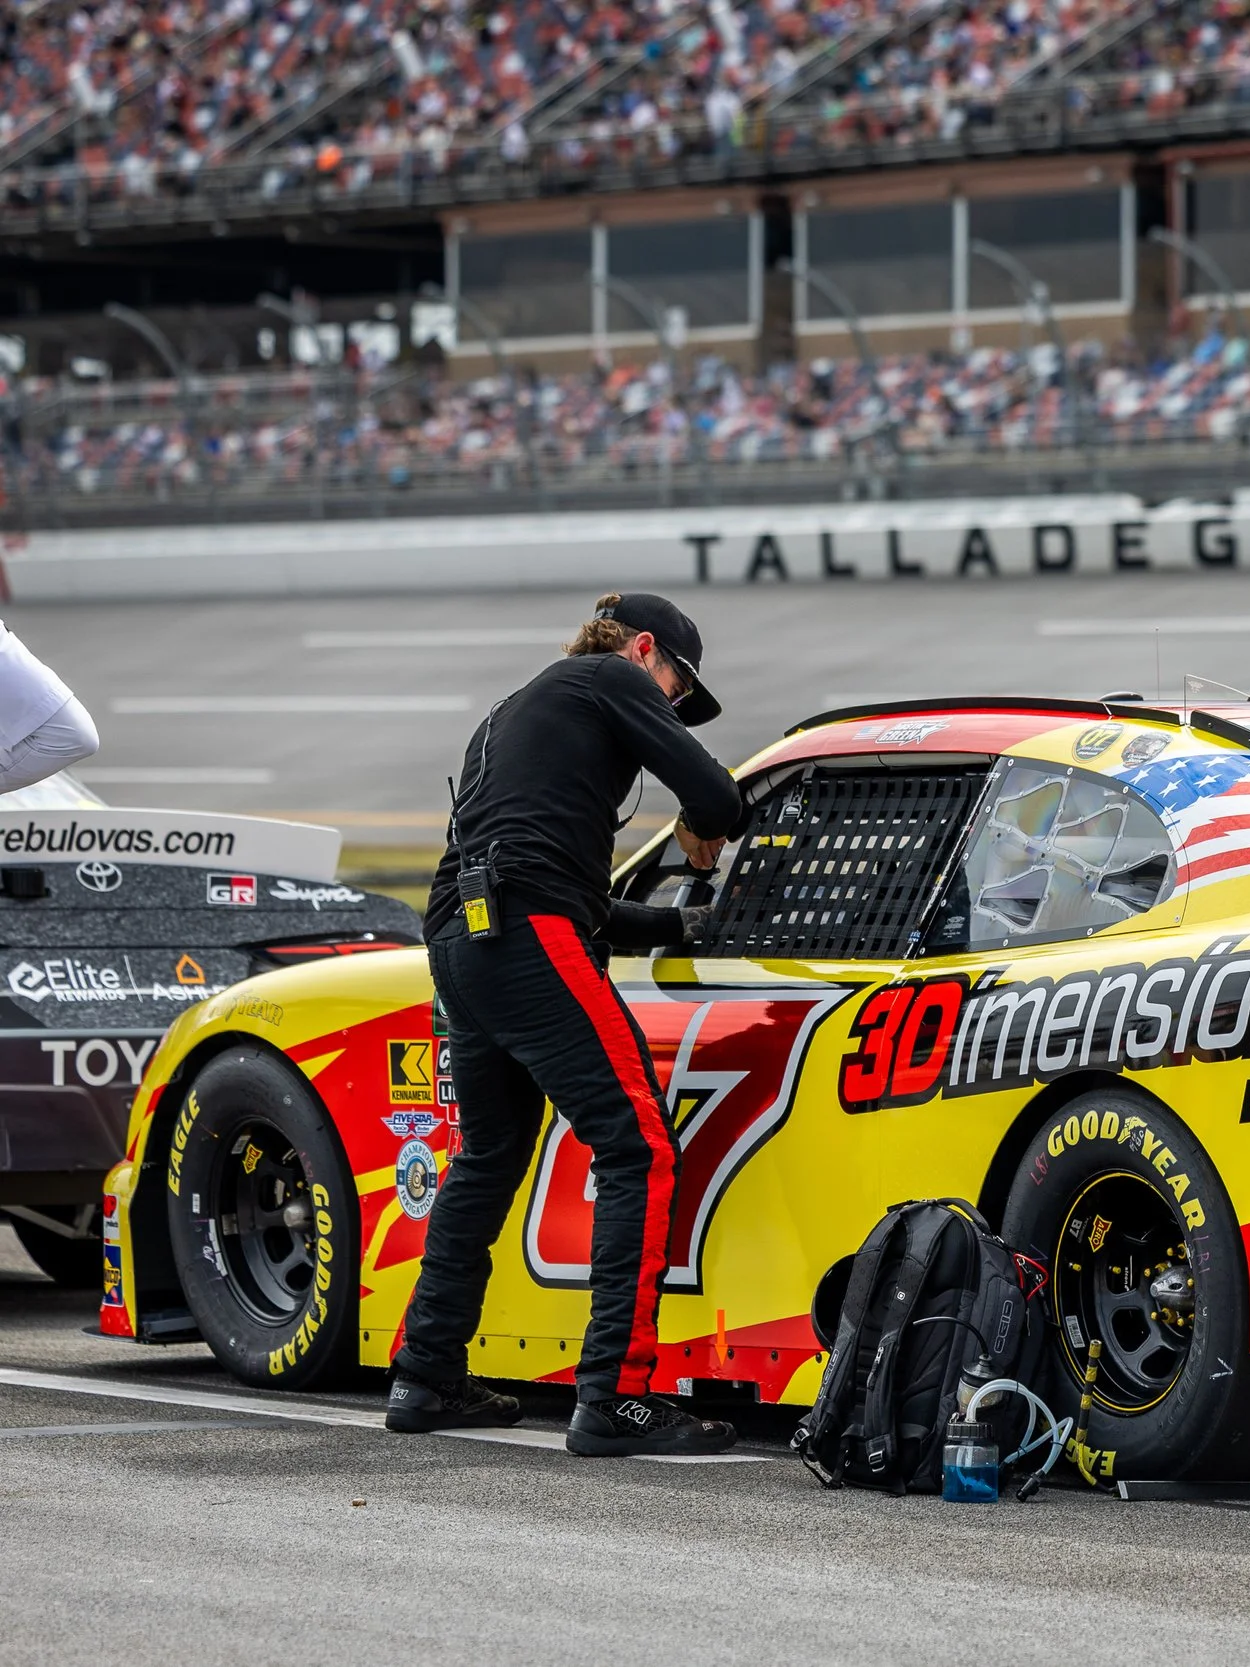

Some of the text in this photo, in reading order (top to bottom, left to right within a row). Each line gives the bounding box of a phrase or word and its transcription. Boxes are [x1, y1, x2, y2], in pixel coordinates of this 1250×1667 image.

[210, 886, 255, 901] GR
[269, 880, 365, 911] Supra
[44, 959, 120, 990] Elite
[56, 988, 127, 1002] REWARDS
[41, 1039, 157, 1087] TOY
[391, 1089, 432, 1102] KENNAMETAL
[393, 1114, 433, 1125] FIVE STAR
[167, 1089, 201, 1198] EAGLE
[400, 1144, 434, 1169] CHAMPION
[1046, 1109, 1208, 1232] GOODYEAR
[400, 1188, 434, 1216] IRRIGATION
[1091, 1220, 1105, 1246] AERO
[267, 1182, 334, 1376] GOODYEAR
[617, 1400, 652, 1425] K1
